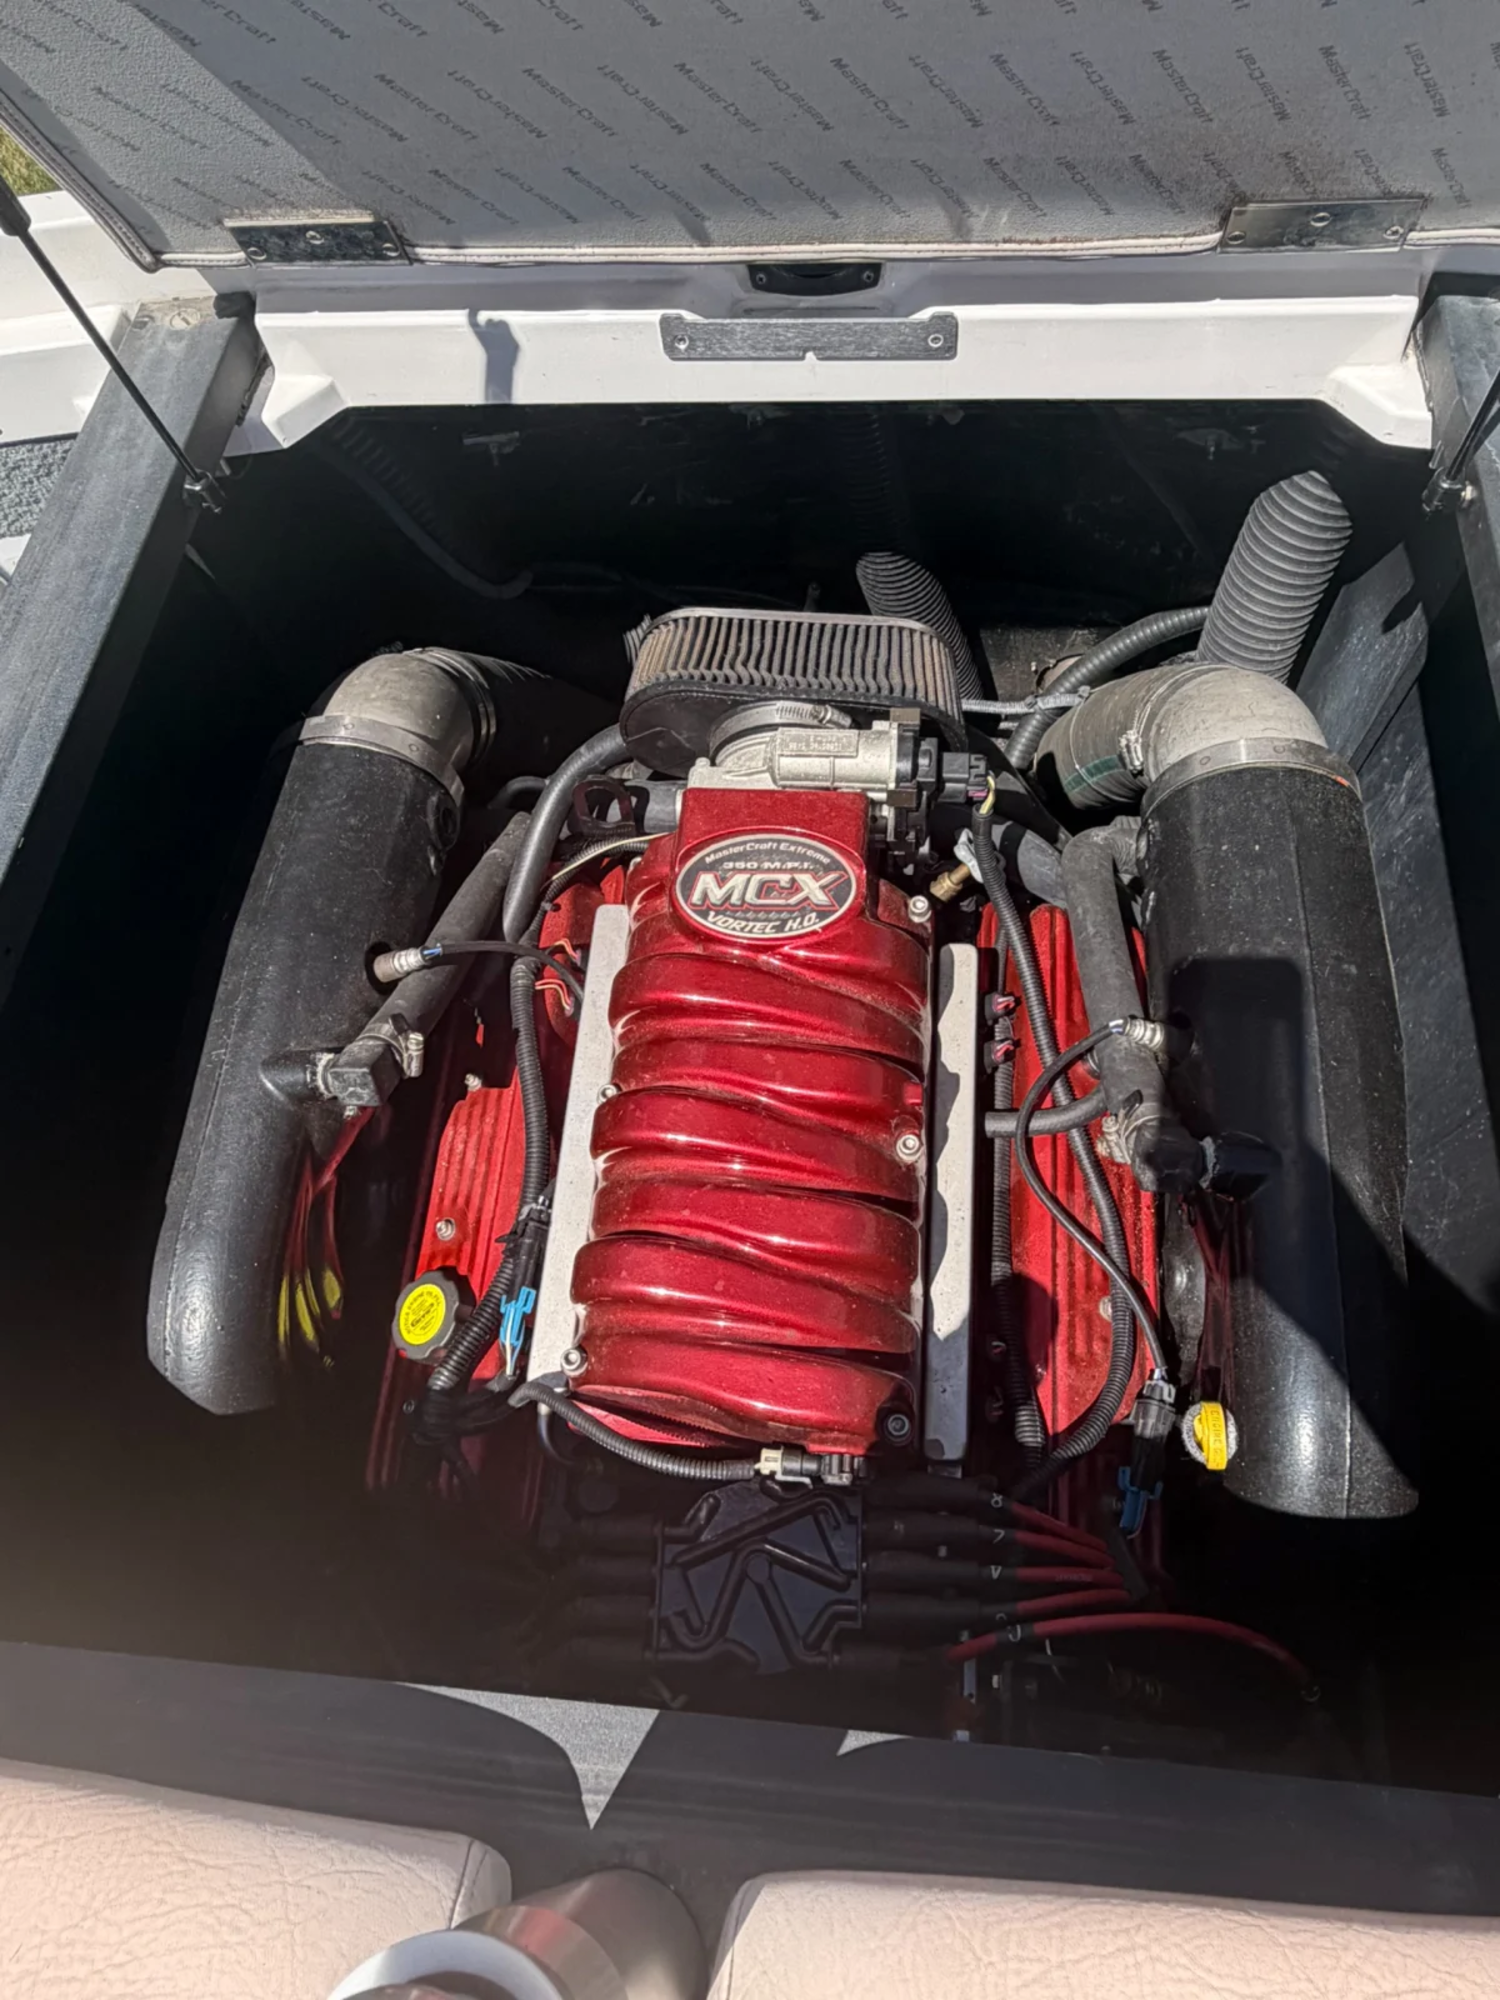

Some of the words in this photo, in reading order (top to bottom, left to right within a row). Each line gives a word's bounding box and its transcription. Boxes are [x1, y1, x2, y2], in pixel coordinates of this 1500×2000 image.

[301, 75, 408, 143] MasterCraft
[373, 73, 479, 141] MasterCraft
[447, 70, 547, 139] MasterCraft
[521, 67, 618, 137] MasterCraft
[597, 64, 689, 136] MasterCraft
[673, 62, 763, 134] MasterCraft
[750, 58, 835, 132] MasterCraft
[829, 57, 910, 130] MasterCraft
[909, 54, 984, 129] MasterCraft
[989, 53, 1060, 127] MasterCraft
[1069, 51, 1136, 126] MasterCraft
[1152, 49, 1214, 124] MasterCraft
[1235, 47, 1292, 122] MasterCraft
[1317, 44, 1373, 121] MasterCraft
[1403, 41, 1451, 118] MasterCraft
[704, 842, 778, 863] MasterCraft
[779, 842, 831, 864] Extreme
[723, 861, 758, 870] 350
[688, 871, 848, 910] MCX
[707, 911, 780, 934] VORTEC
